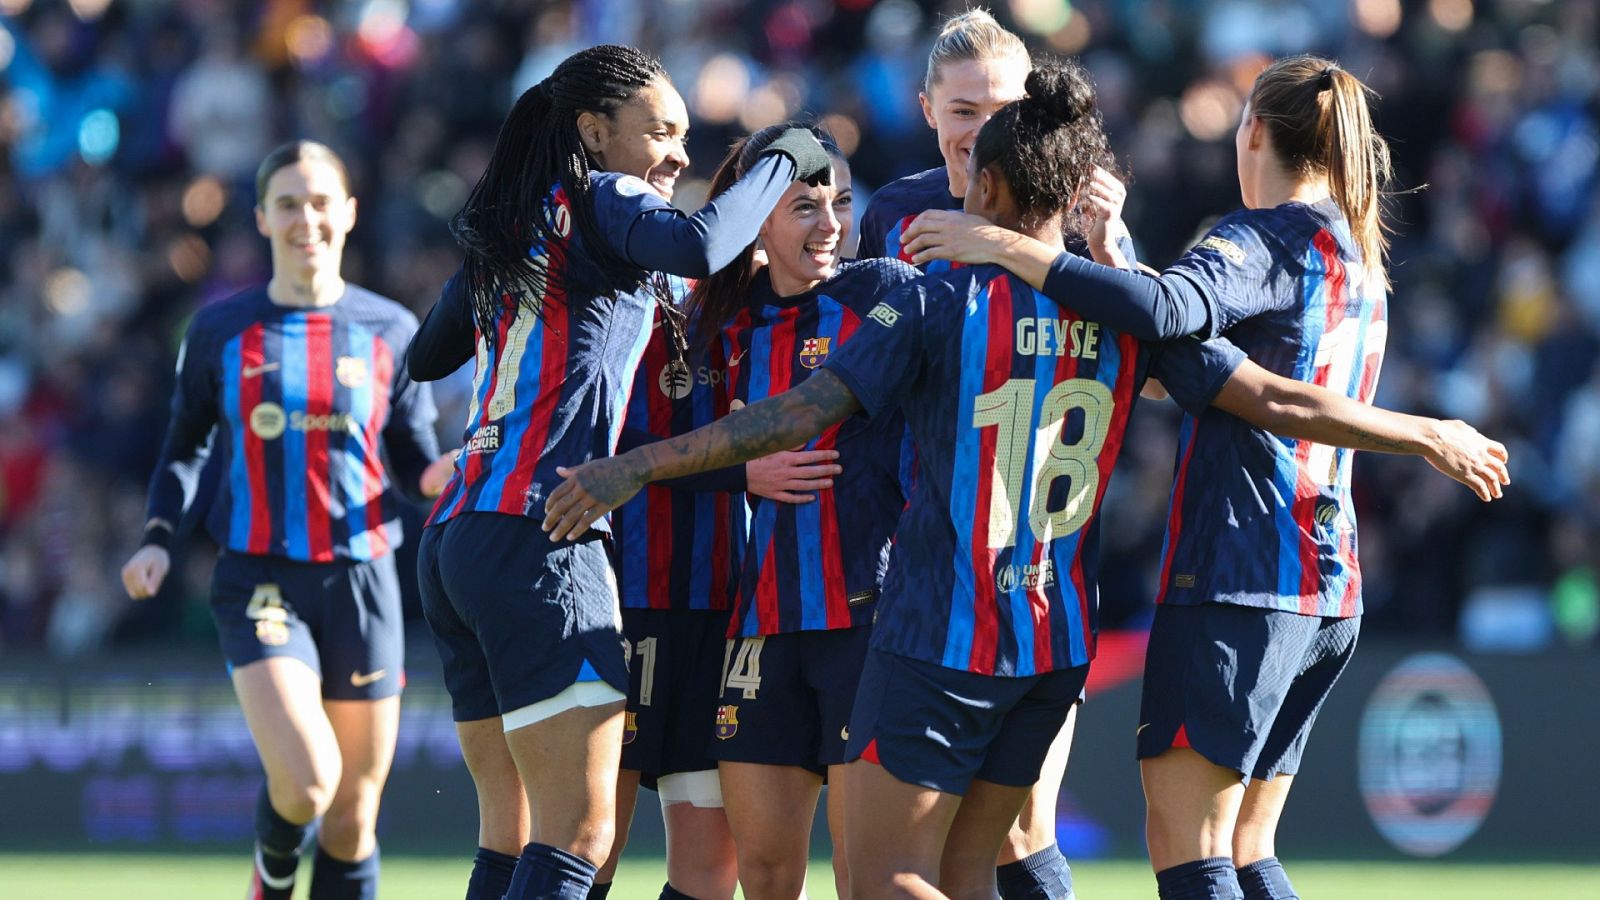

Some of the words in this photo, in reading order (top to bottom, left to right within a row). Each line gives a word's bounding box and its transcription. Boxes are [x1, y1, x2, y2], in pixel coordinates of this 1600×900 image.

[1016, 317, 1099, 360] GEYSE
[972, 378, 1115, 548] 18
[1020, 570, 1054, 587] ACUR
